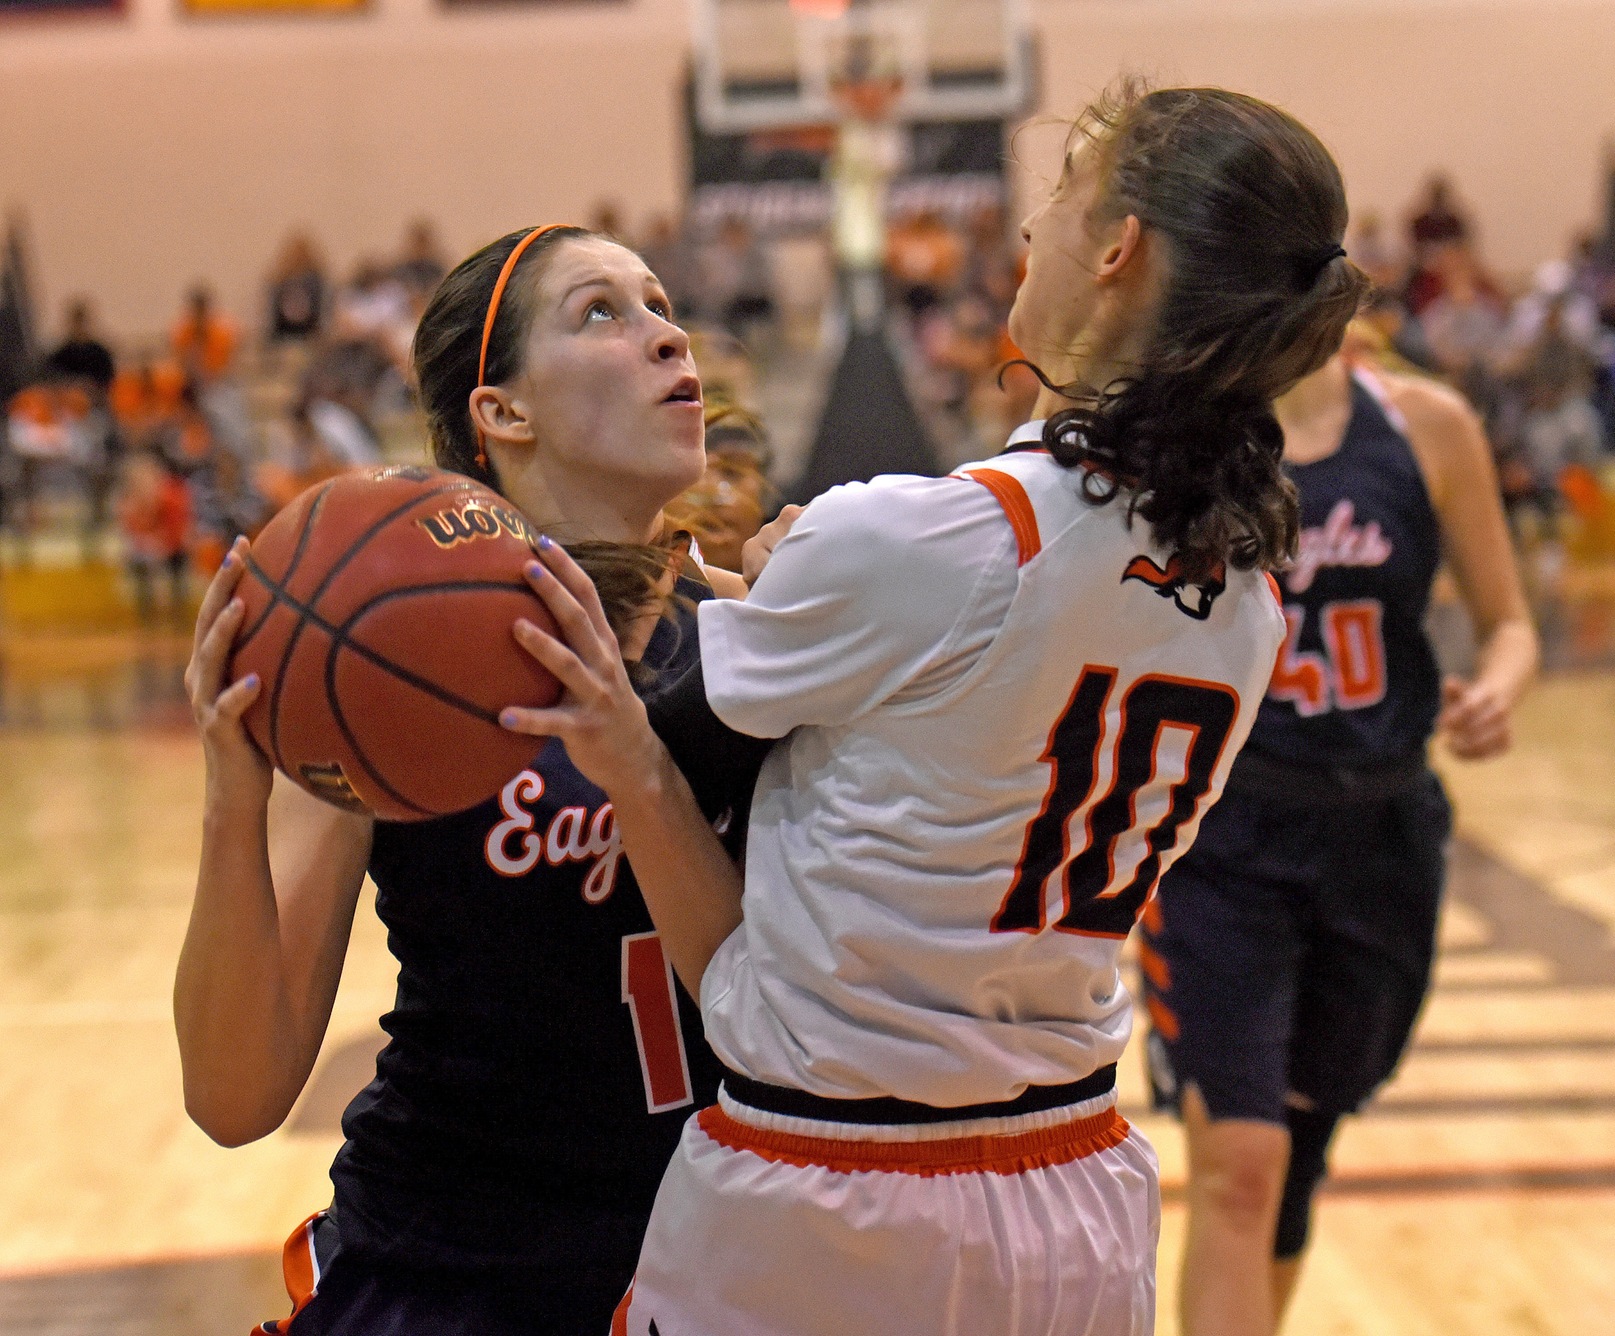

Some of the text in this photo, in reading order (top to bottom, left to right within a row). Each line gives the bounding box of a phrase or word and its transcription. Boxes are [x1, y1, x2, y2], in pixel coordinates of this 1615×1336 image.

[1286, 499, 1393, 593] gles
[1268, 599, 1388, 717] 40
[484, 769, 632, 905] Eag
[989, 663, 1240, 940] 10
[621, 929, 694, 1115] 1
